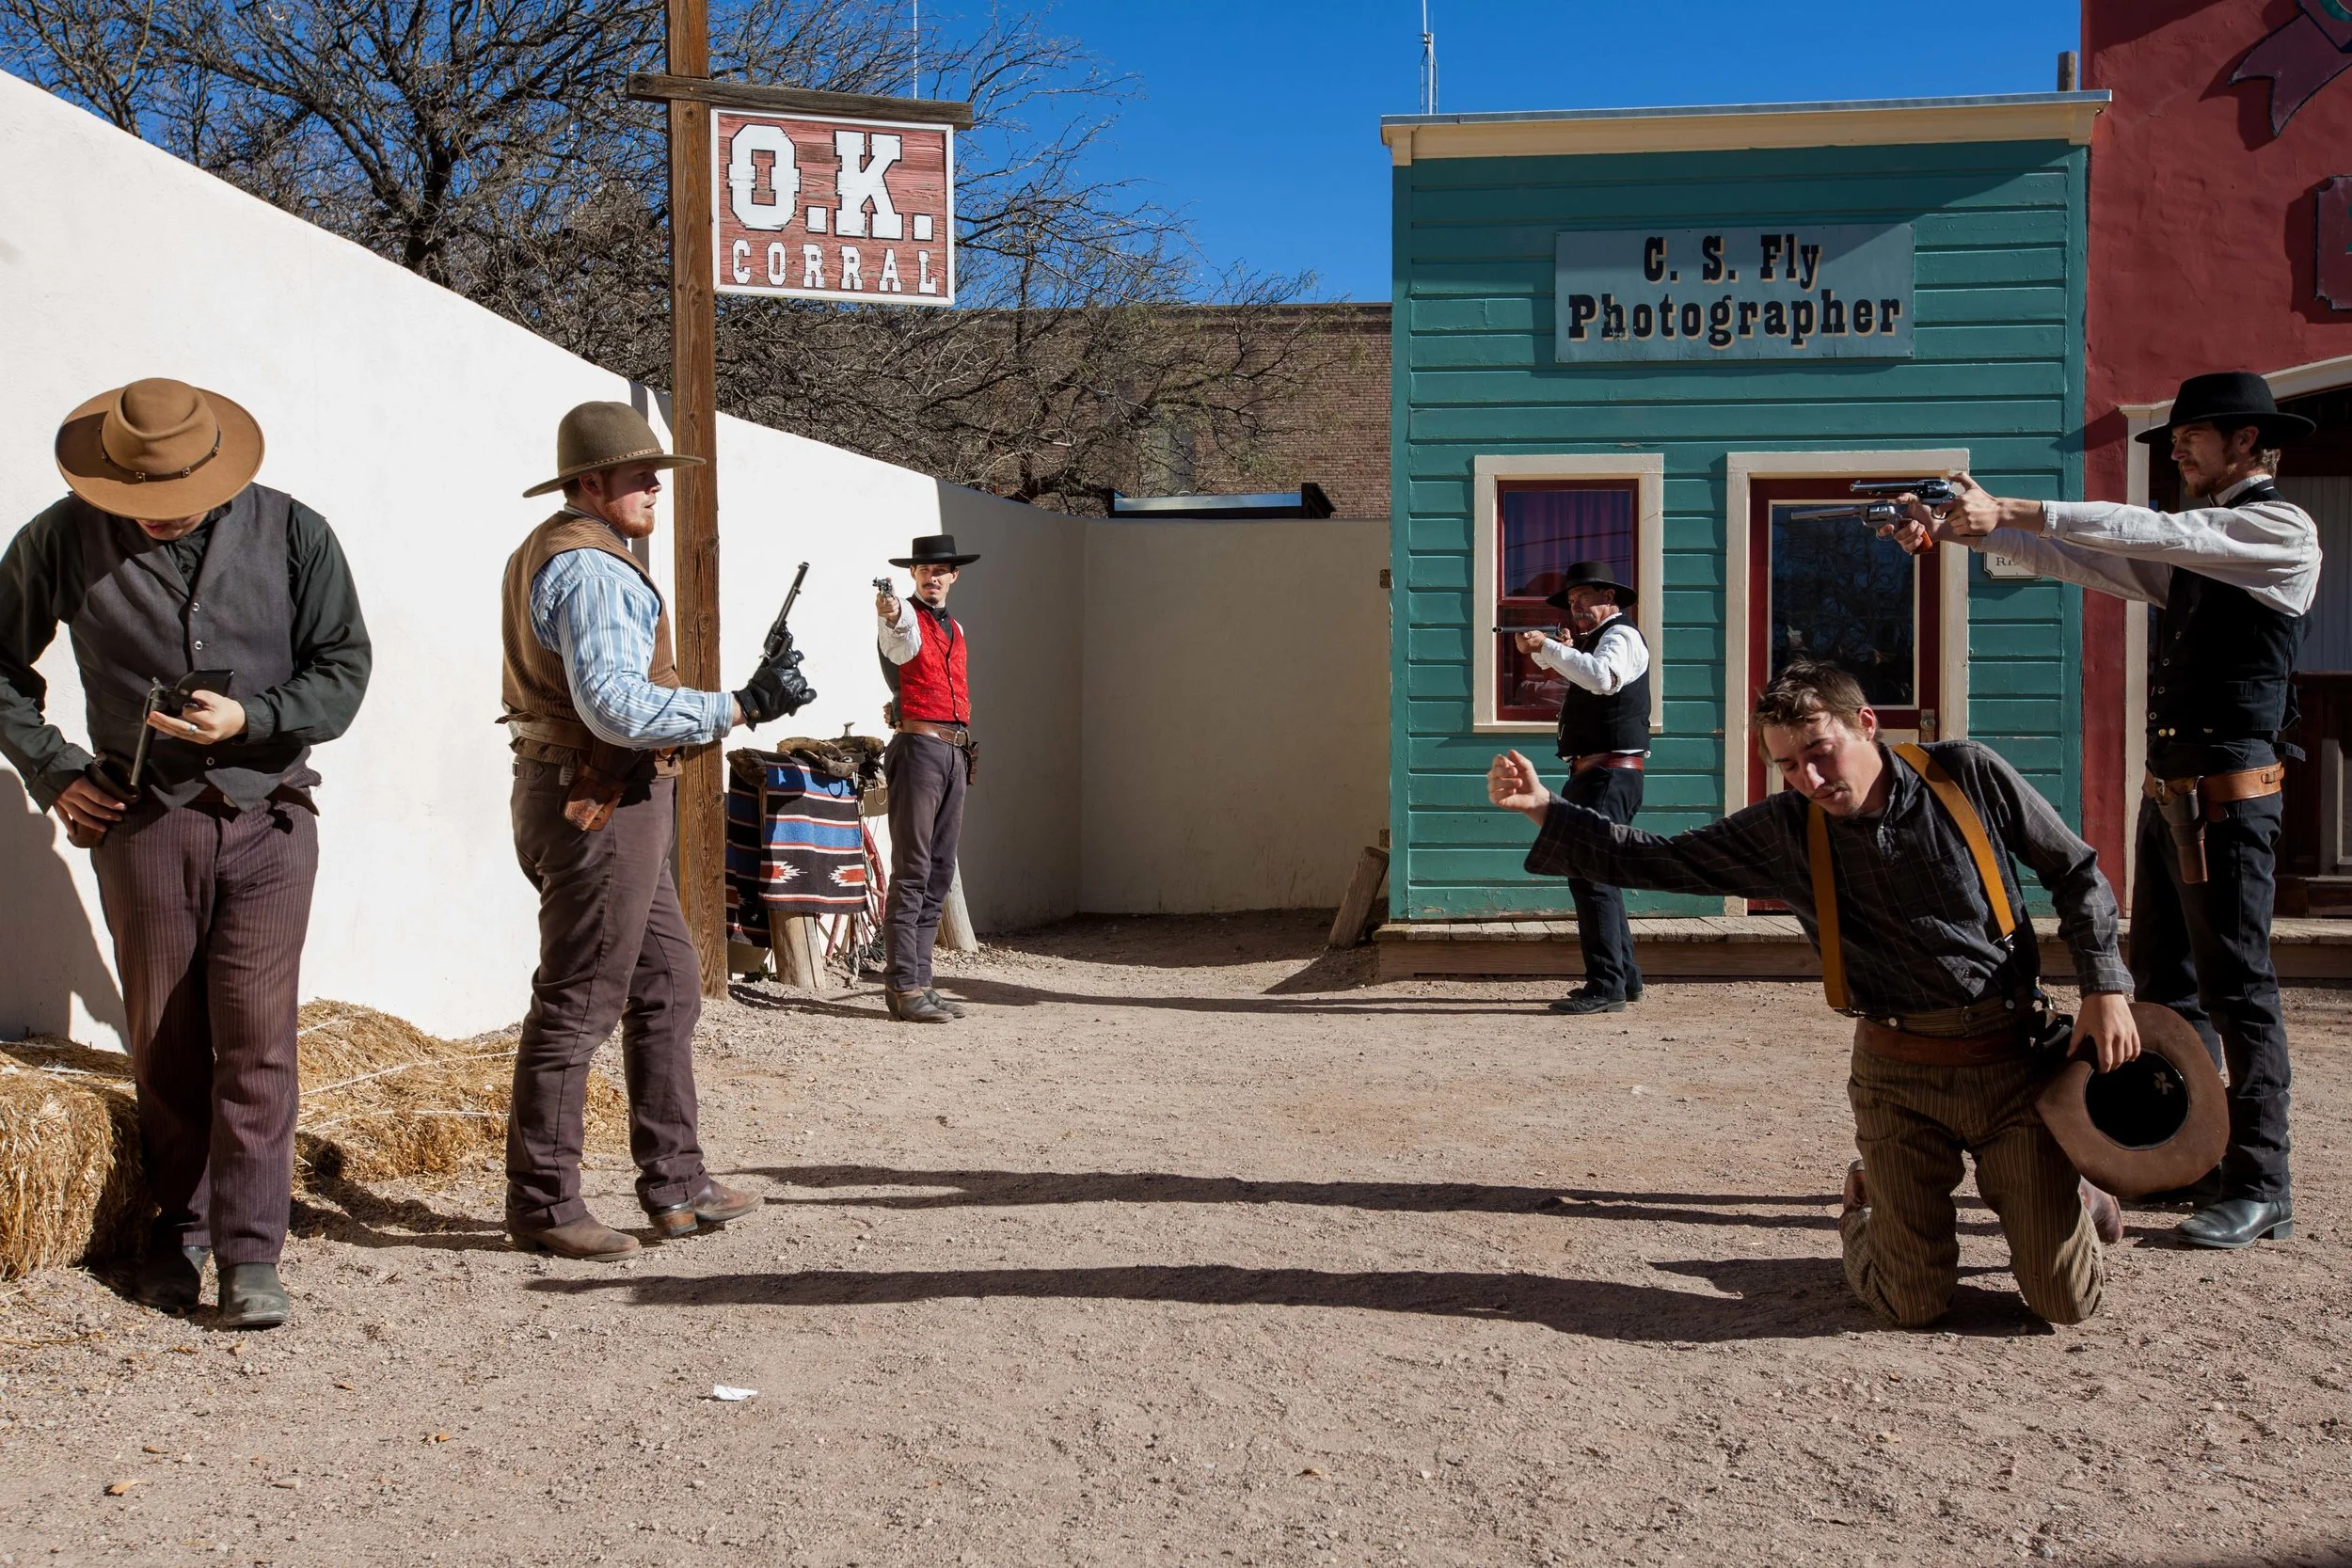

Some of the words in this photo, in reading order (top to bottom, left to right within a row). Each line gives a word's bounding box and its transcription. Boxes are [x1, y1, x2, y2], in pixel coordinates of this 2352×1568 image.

[727, 123, 934, 241] O.K.
[731, 239, 938, 294] CORRAL
[1644, 236, 1679, 284] C.
[1702, 234, 1739, 282] S.
[1760, 233, 1821, 292] Fly
[1568, 290, 1901, 350] Photographer
